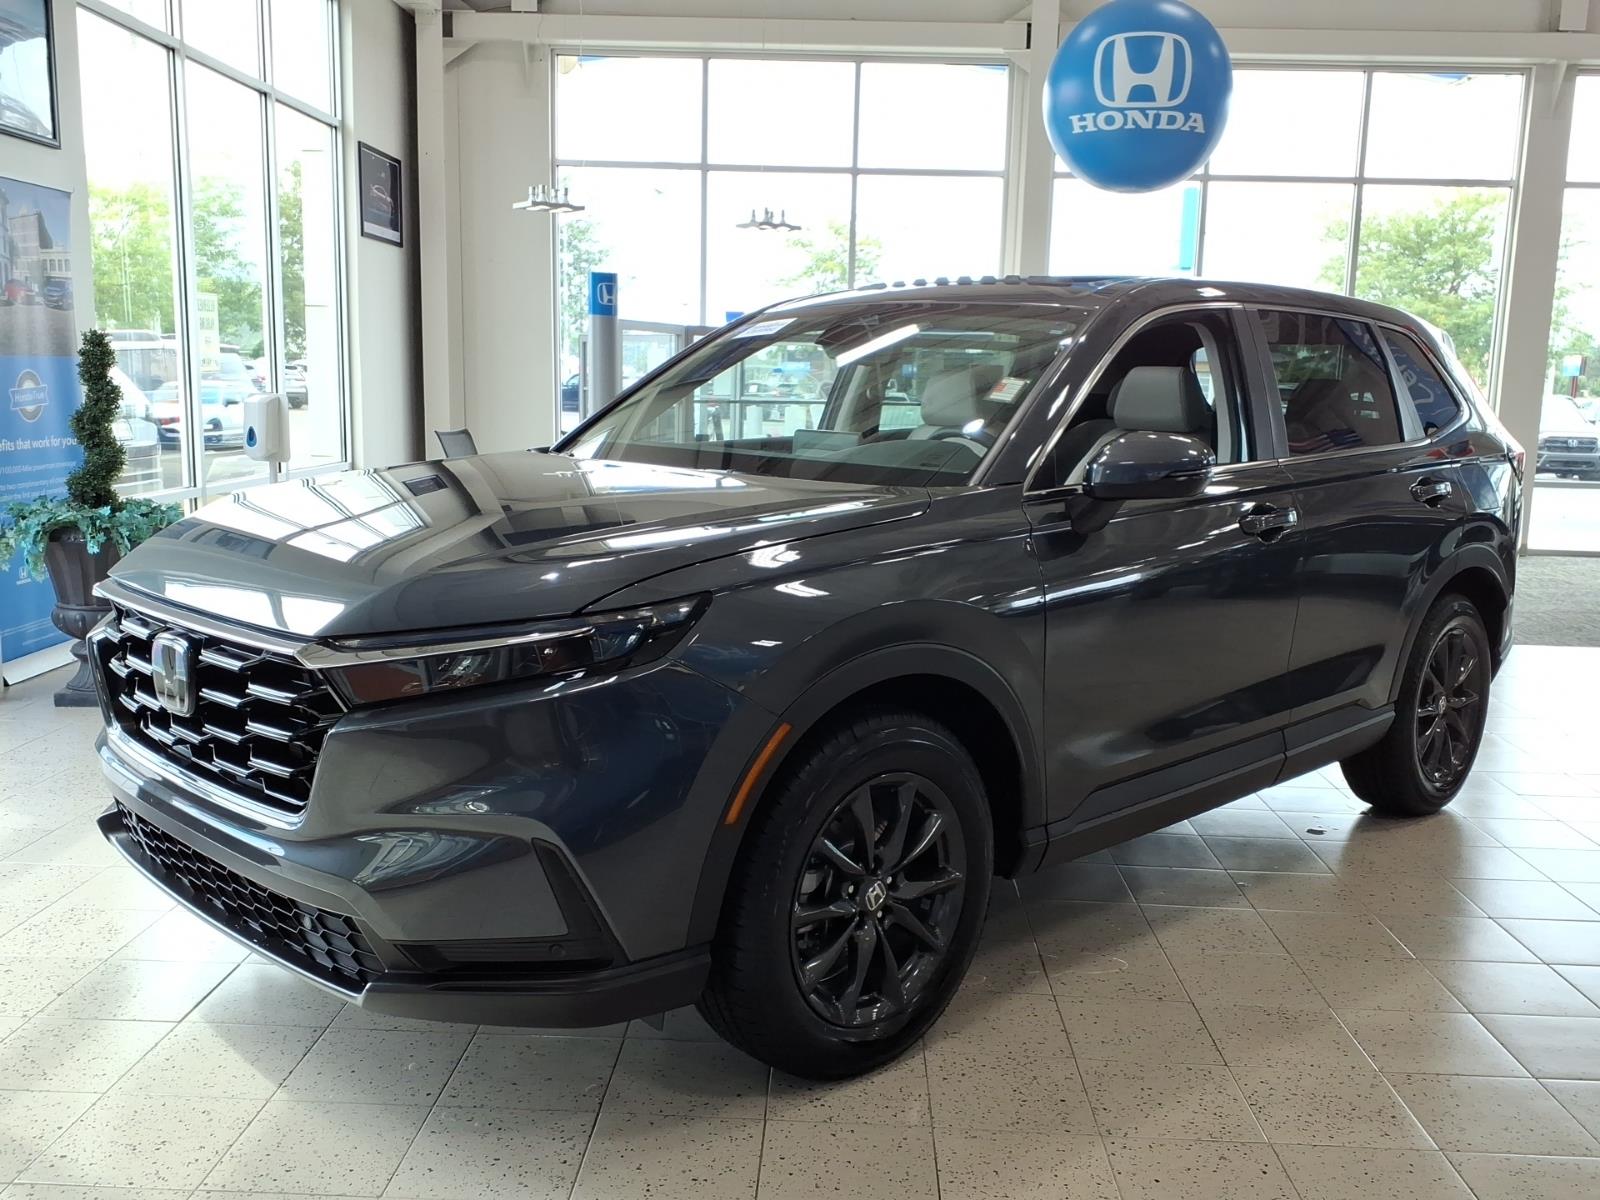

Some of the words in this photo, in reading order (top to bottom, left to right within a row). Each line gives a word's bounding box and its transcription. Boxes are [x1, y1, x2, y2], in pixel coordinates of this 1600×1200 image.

[1068, 110, 1206, 134] HONDA
[16, 437, 31, 450] that
[32, 436, 50, 449] work
[50, 435, 61, 448] for
